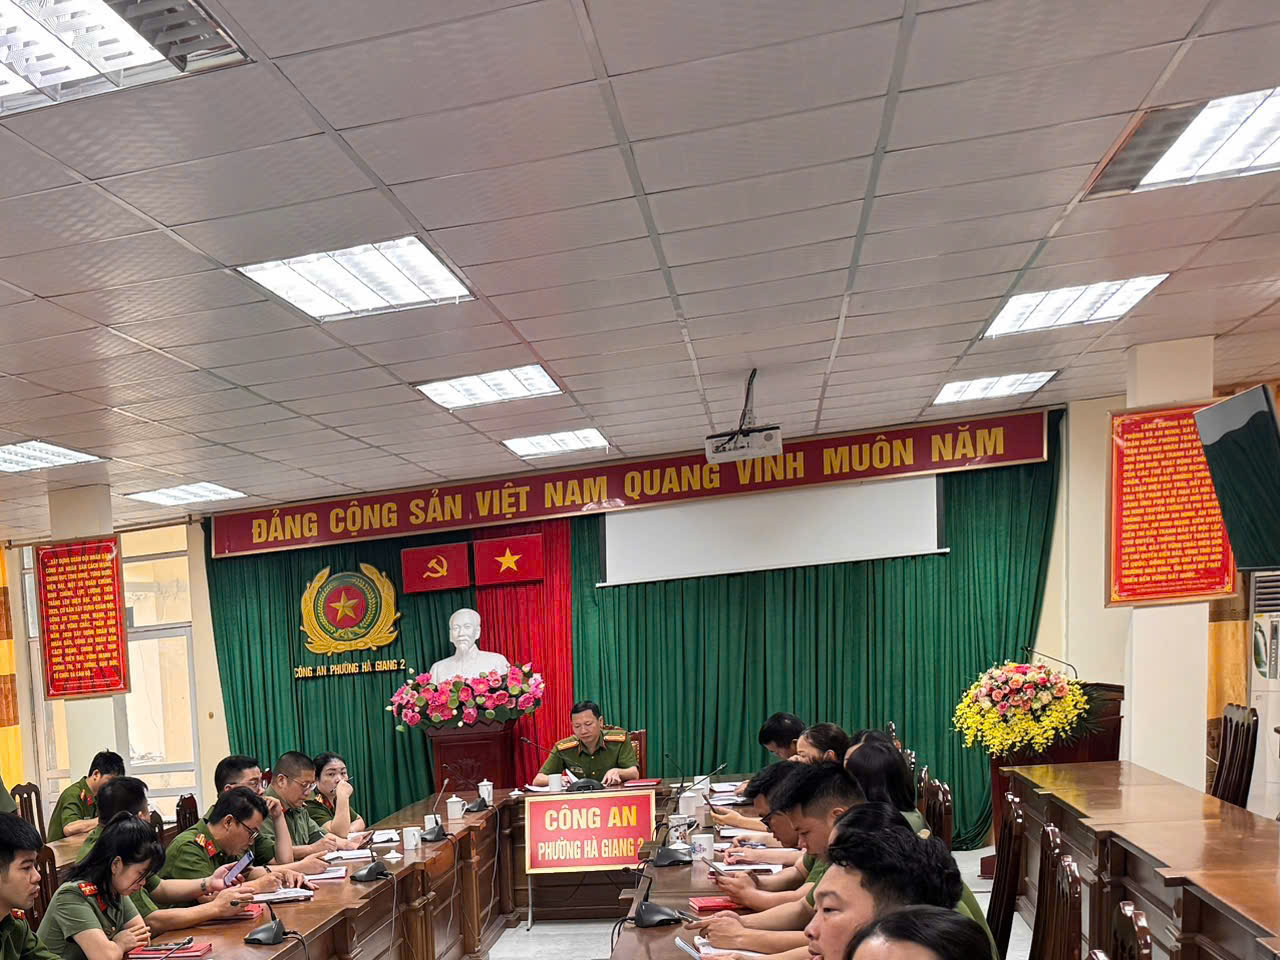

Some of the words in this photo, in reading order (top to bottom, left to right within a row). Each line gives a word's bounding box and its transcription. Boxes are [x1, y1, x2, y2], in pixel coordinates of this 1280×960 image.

[252, 509, 318, 543] ĐẢNG
[329, 500, 398, 536] CỘNG
[409, 488, 463, 525] SẢN
[476, 482, 531, 519] VIỆT
[545, 475, 608, 508] NAM
[624, 463, 720, 500] QUANG
[735, 450, 805, 486] VINH
[823, 434, 915, 475] MUÔN
[931, 423, 1004, 462] NĂM
[293, 664, 313, 678] CÔNG
[316, 664, 327, 677] AN
[330, 660, 359, 676] PHƯỜNG
[362, 658, 373, 673] HÀ
[375, 657, 398, 672] GIANG
[400, 659, 406, 670] 2
[545, 804, 601, 831] CÔNG
[608, 806, 636, 827] AN
[539, 837, 581, 860] PHƯỜNG
[584, 836, 598, 858] HÀ
[601, 837, 635, 857] GIANG
